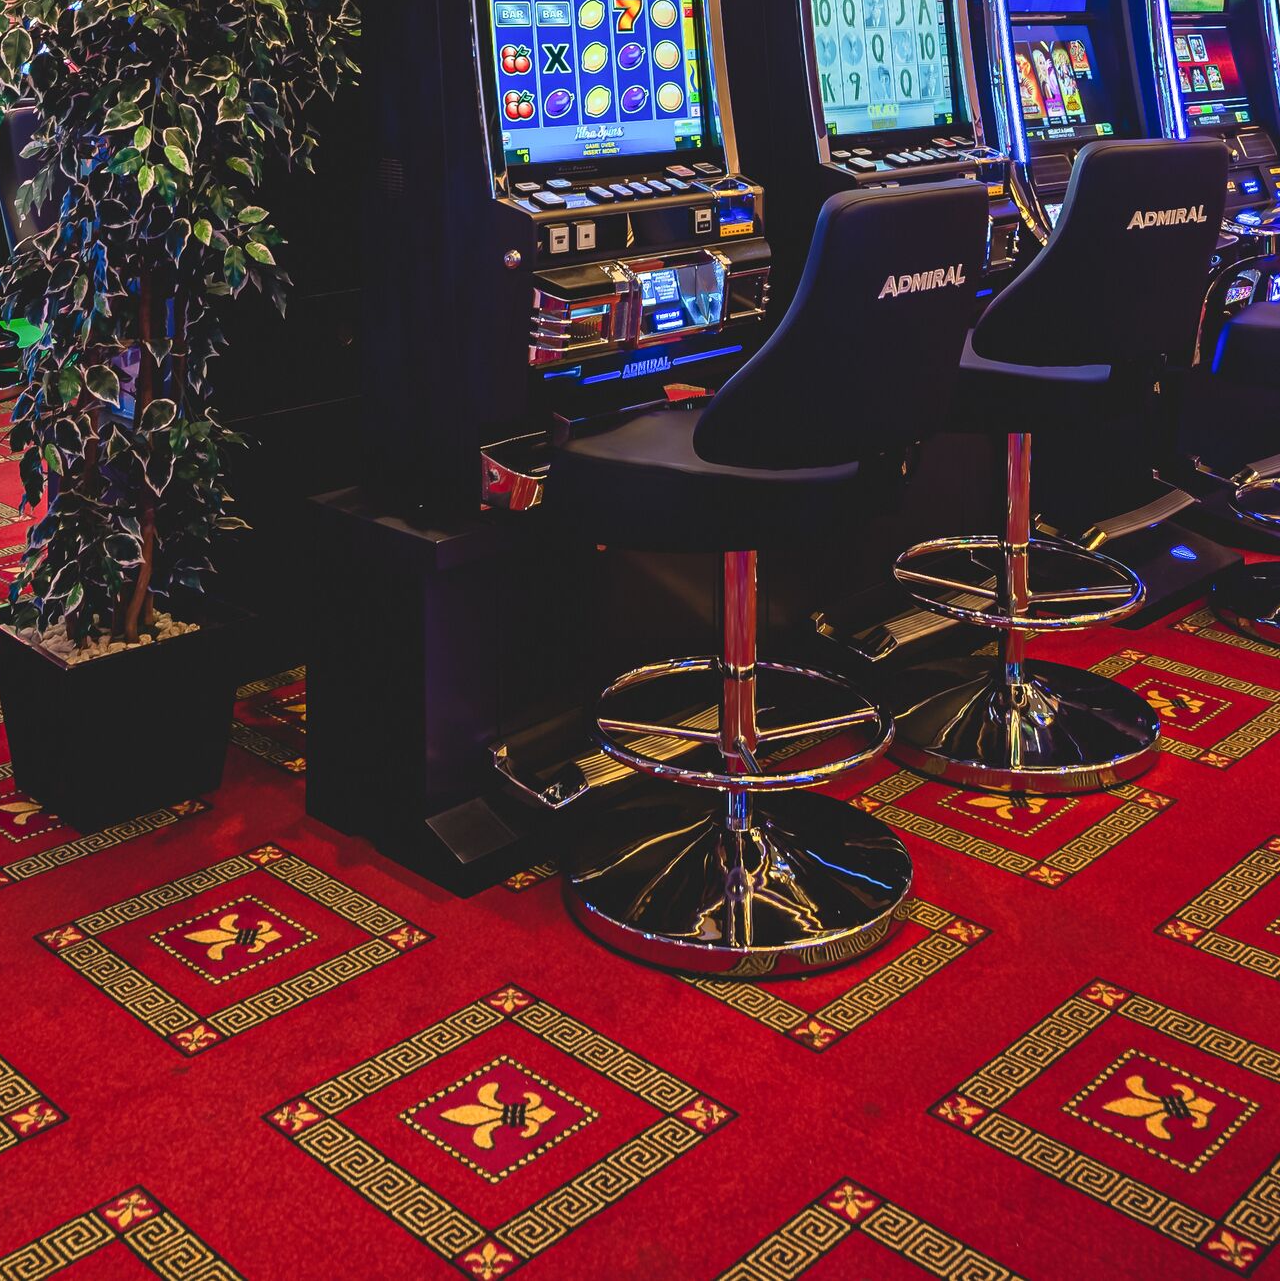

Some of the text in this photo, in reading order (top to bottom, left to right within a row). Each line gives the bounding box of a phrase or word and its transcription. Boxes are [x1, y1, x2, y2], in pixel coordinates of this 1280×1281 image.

[502, 10, 524, 19] BAR
[542, 9, 564, 19] BAR
[542, 43, 572, 74] X
[871, 34, 885, 63] Q
[919, 32, 936, 60] 10
[848, 71, 861, 101] 9
[900, 69, 913, 98] Q
[1126, 204, 1208, 230] ADMIRAL
[878, 263, 967, 299] ADMIRAL
[622, 356, 671, 377] ADMIRAL
